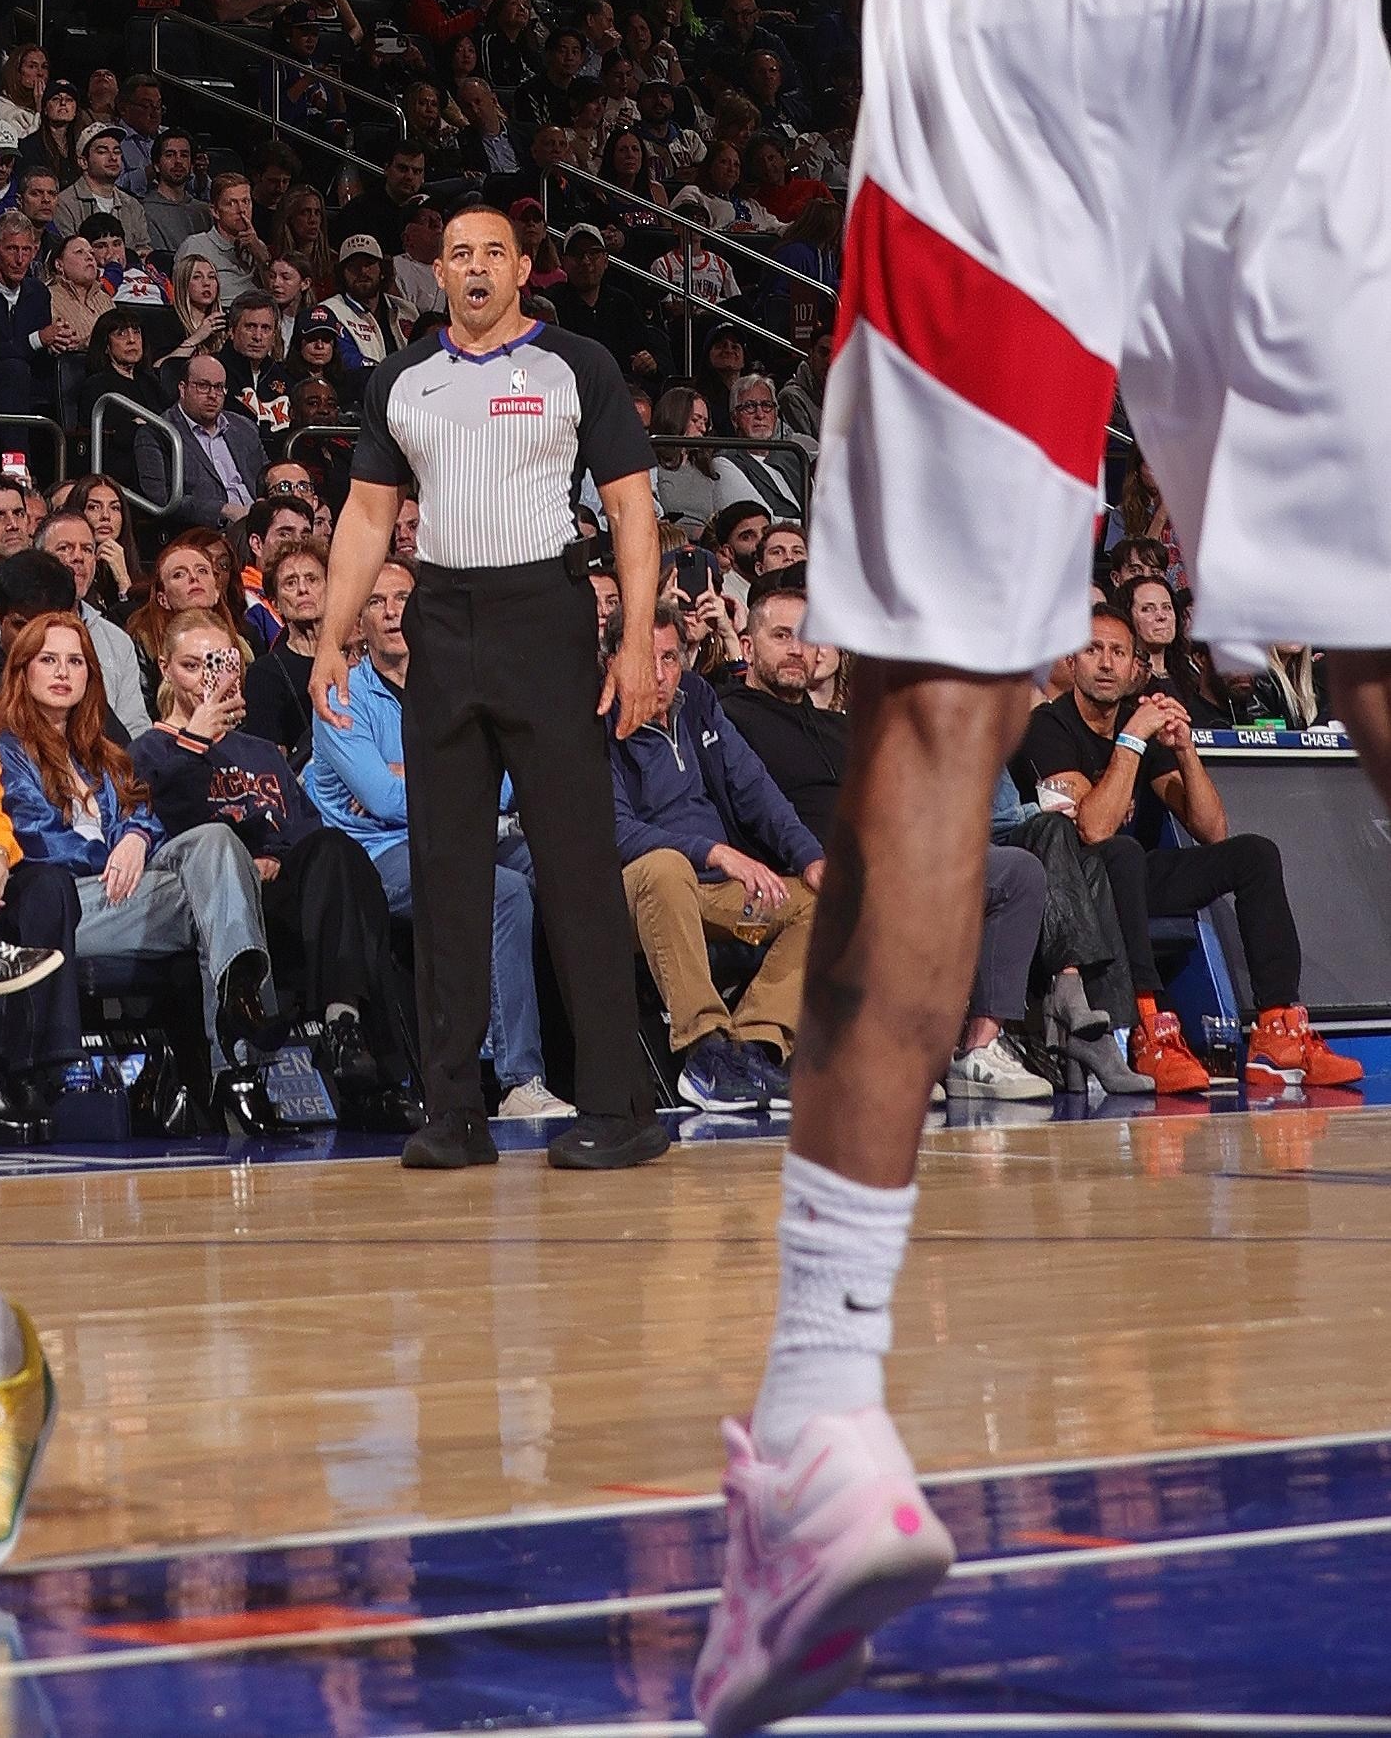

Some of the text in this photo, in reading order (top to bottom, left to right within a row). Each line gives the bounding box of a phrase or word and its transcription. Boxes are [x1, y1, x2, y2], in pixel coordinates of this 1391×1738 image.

[794, 303, 814, 322] 107
[491, 400, 543, 414] Emirates
[1190, 730, 1215, 745] ASE
[1237, 731, 1277, 745] CHASE
[1300, 732, 1339, 748] CHASE
